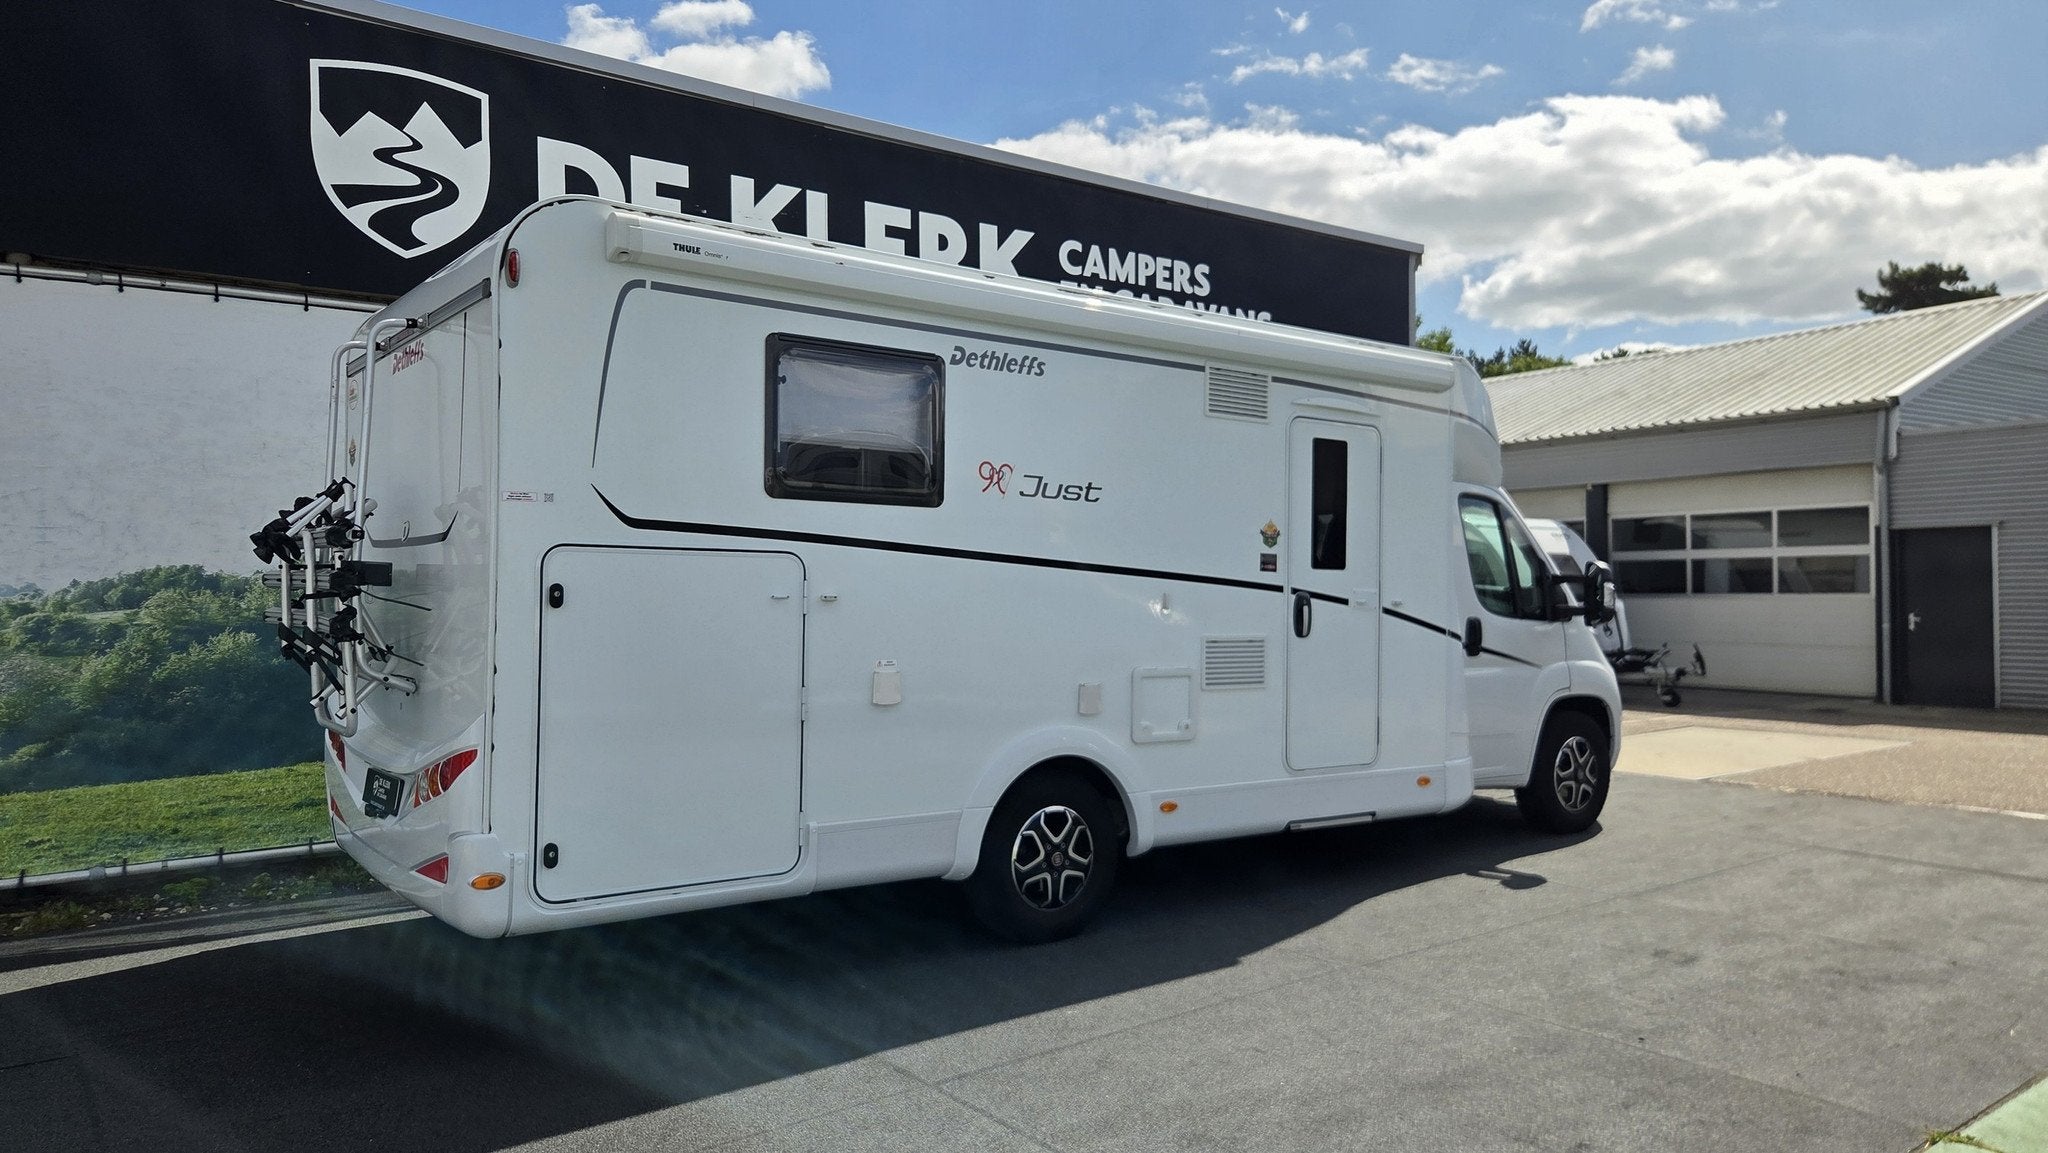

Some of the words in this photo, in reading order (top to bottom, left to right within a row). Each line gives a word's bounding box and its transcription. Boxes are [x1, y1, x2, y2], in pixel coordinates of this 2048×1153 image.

[673, 242, 701, 255] THULE
[1058, 239, 1212, 297] CAMPERS
[950, 345, 1046, 377] Dethleffs
[1019, 474, 1102, 502] Just
